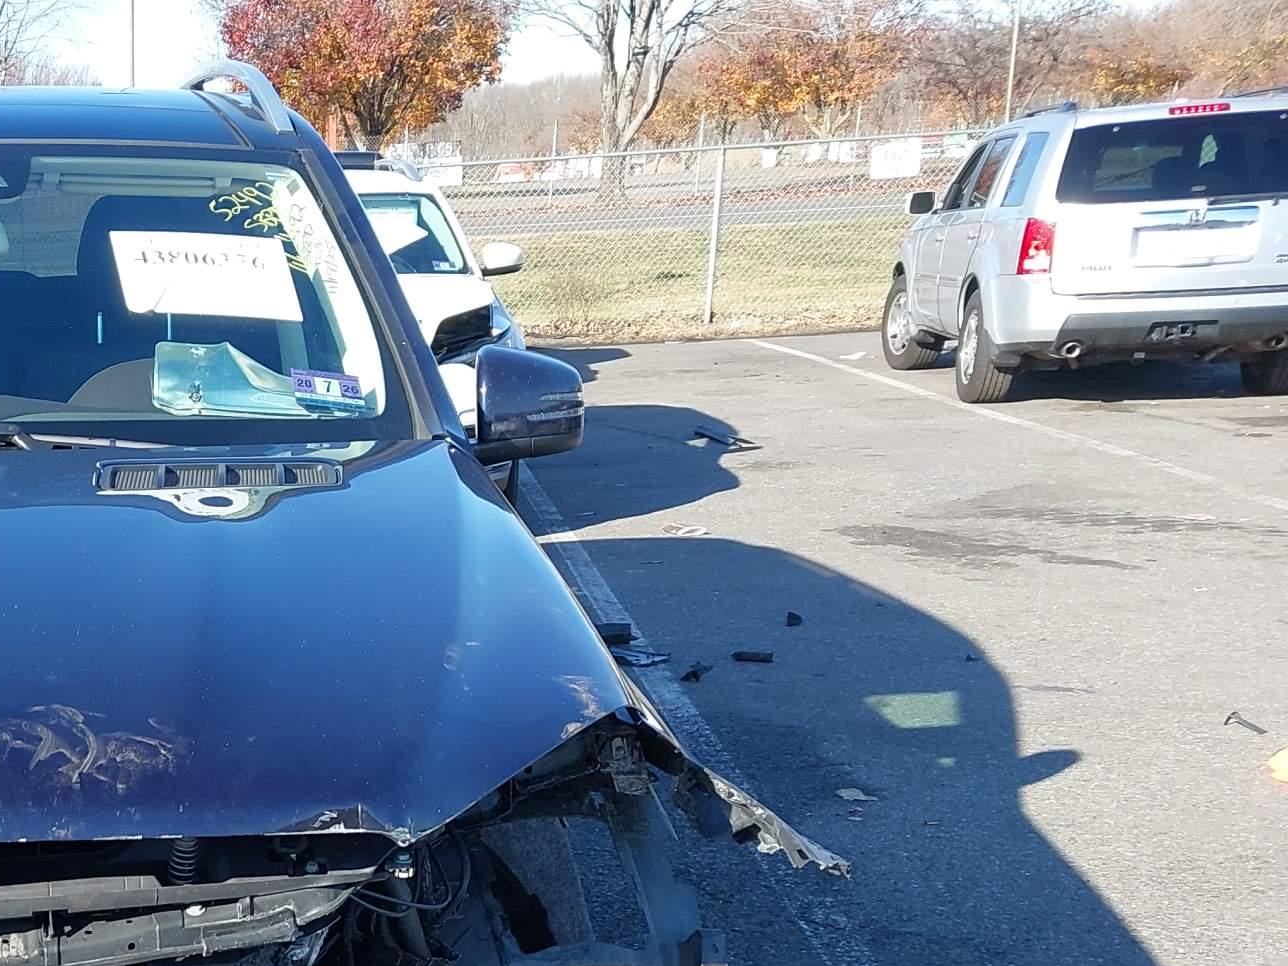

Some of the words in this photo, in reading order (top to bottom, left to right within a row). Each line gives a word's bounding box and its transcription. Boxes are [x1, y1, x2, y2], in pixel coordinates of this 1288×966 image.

[296, 378, 312, 388] 20
[322, 380, 332, 393] 7
[342, 384, 360, 394] 26
